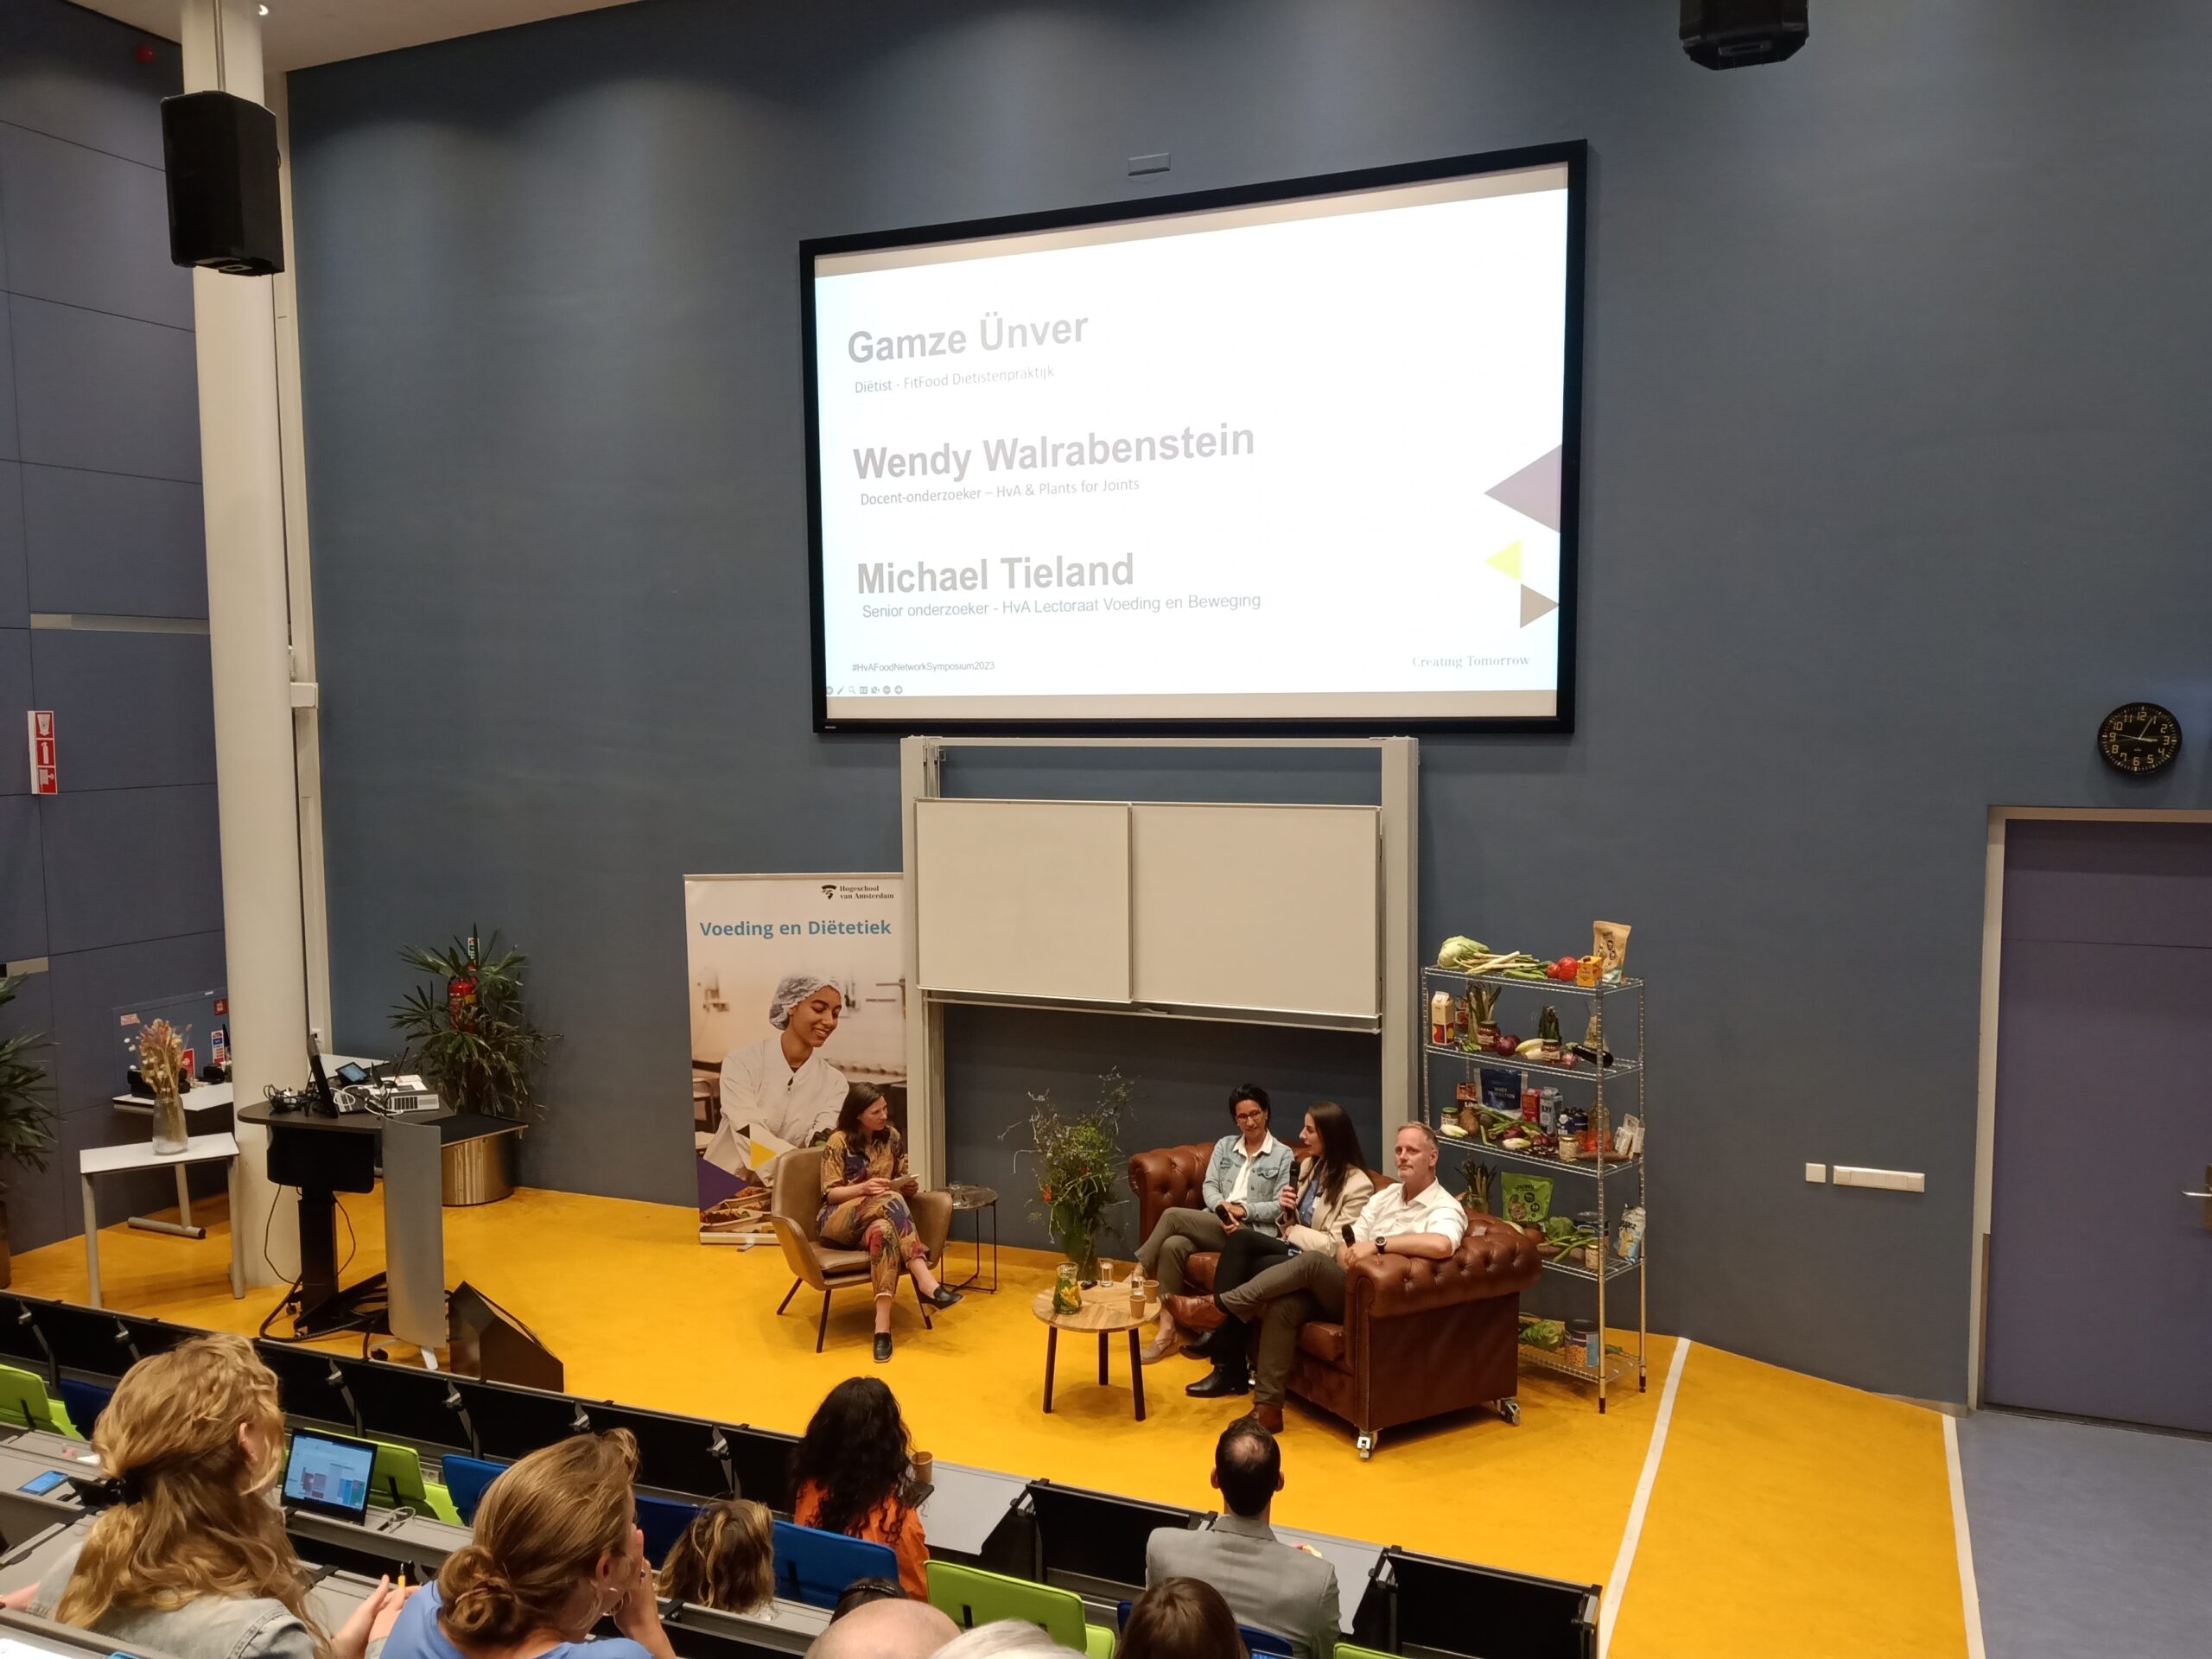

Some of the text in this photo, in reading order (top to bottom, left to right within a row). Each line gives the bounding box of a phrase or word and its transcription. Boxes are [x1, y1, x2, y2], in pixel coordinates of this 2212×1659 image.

[848, 311, 1089, 363] Gamze Ünver
[855, 379, 893, 394] Diëtist
[904, 372, 949, 390] FitFood
[852, 423, 1254, 482] Wendy Walrabenstein
[860, 486, 982, 505] Docent-onderzoeker
[996, 485, 1022, 498] HvA
[1025, 483, 1035, 496] &
[1039, 481, 1077, 495] Plants
[1080, 480, 1098, 493] for
[1102, 478, 1140, 492] Joints
[857, 552, 1134, 594] Michael Tieland
[862, 603, 904, 619] Senior
[907, 602, 989, 617] onderzoeker
[1002, 600, 1032, 614] HvA
[1033, 597, 1099, 613] Lectoraat
[1103, 596, 1161, 613] Voeding
[1165, 598, 1183, 609] en
[1187, 594, 1262, 610] Beweging
[851, 661, 995, 673] #HvAFoodNetworkSymposium2023
[1412, 655, 1531, 670] Creating Tomorrow
[2124, 714, 2133, 723] 11
[2137, 711, 2147, 721] 12
[2152, 715, 2158, 725] 1
[2113, 721, 2124, 731] 10
[2160, 723, 2168, 734] 2
[2109, 732, 2117, 741] 9
[2163, 735, 2171, 746] 3
[2111, 744, 2120, 754] 8
[2158, 747, 2165, 756] 4
[2120, 753, 2127, 761] 7
[2133, 757, 2140, 766] 6
[2146, 754, 2154, 764] 5
[700, 920, 892, 939] Voeding en Diëtetiek
